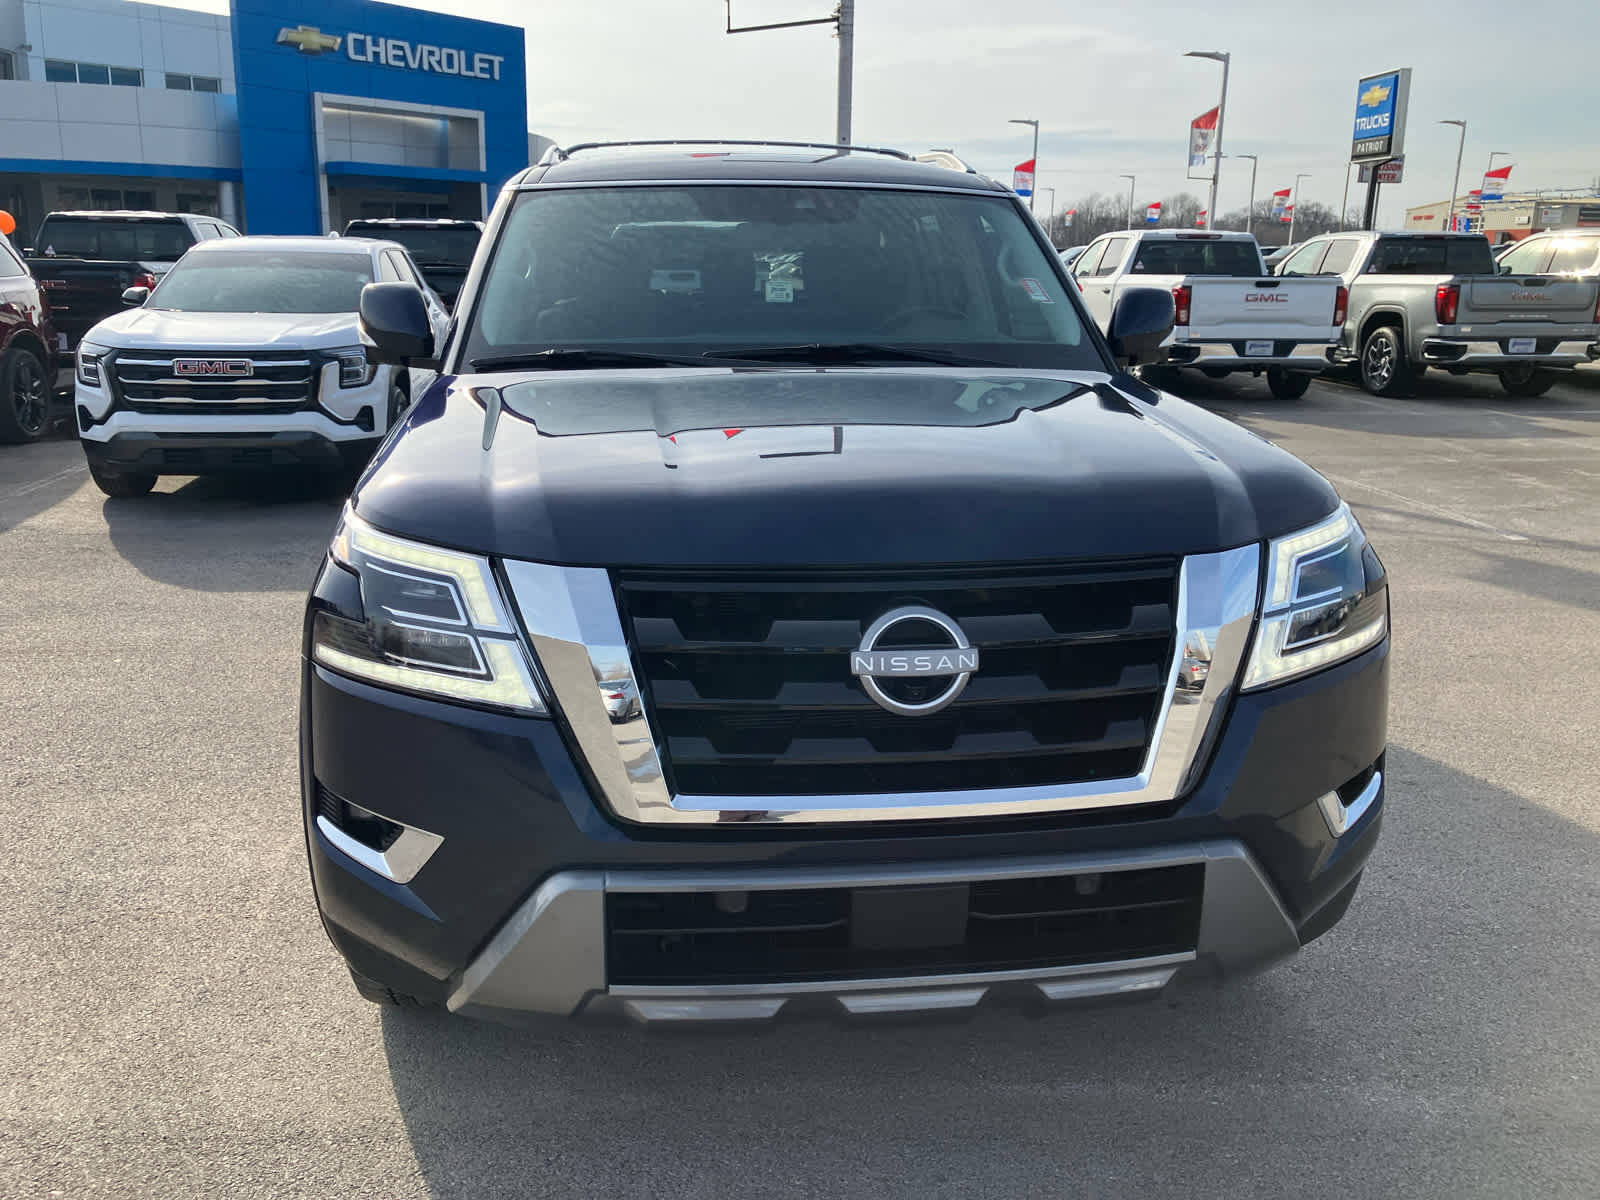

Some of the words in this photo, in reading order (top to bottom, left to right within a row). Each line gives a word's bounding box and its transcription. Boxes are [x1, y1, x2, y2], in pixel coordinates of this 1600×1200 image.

[347, 32, 504, 80] CHEVROLET
[1356, 113, 1390, 130] TRUCKS
[1357, 141, 1384, 152] PATRIOT
[1245, 293, 1289, 302] GMC
[177, 361, 246, 374] GMC
[855, 654, 976, 671] NISSAN
